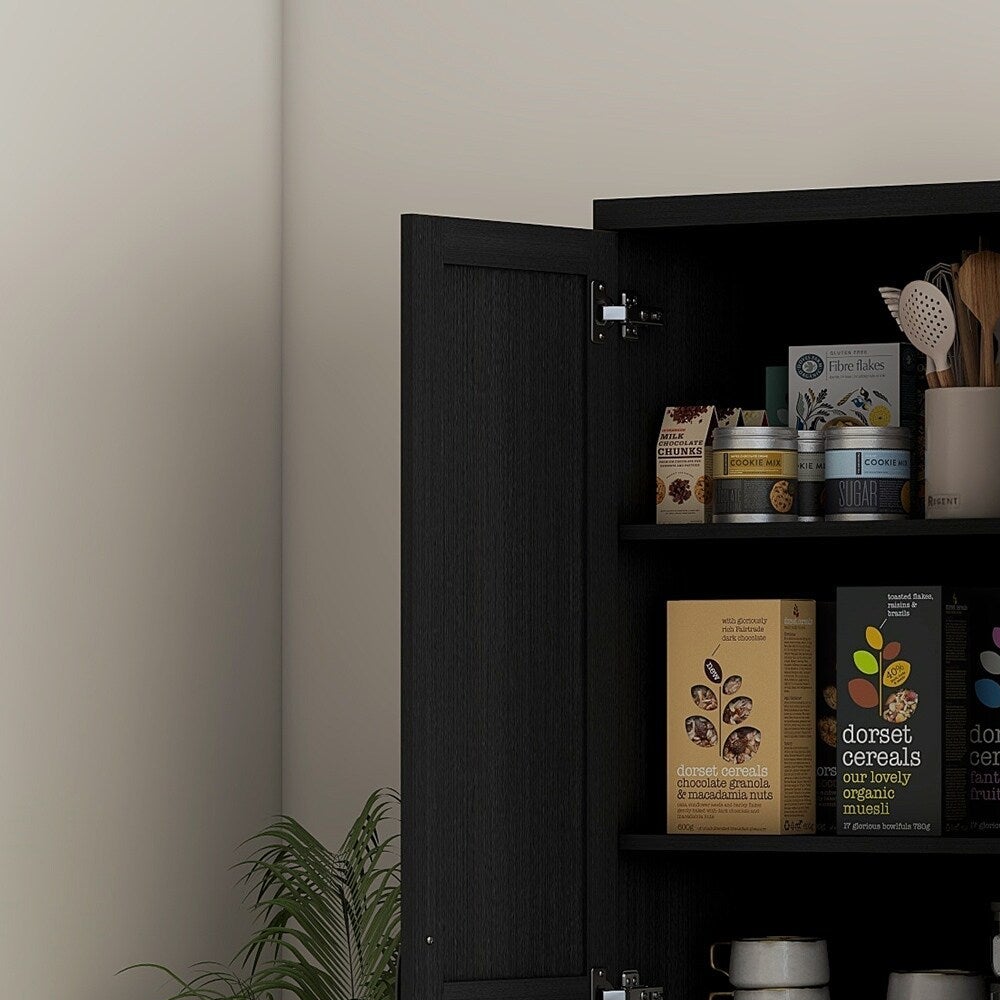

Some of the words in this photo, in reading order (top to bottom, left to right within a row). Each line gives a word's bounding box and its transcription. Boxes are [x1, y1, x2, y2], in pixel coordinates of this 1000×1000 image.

[829, 360, 854, 372] Fibre
[856, 358, 885, 372] flakes
[658, 447, 702, 456] CHUNKS
[730, 459, 763, 467] COOKIE
[765, 459, 781, 467] MIX
[864, 459, 897, 467] COOKIE
[839, 480, 878, 507] SUGAR
[737, 617, 768, 625] gloriously
[706, 661, 720, 681] new
[842, 724, 913, 744] dorset
[842, 747, 921, 767] cereals
[676, 764, 719, 777] dorset
[721, 764, 769, 777] cereals
[817, 766, 837, 777] ors
[676, 778, 727, 788] chocolate
[729, 778, 770, 790] granola
[842, 772, 868, 783] our
[870, 771, 911, 786] lovely
[676, 789, 687, 800] &
[688, 789, 748, 800] macadamia
[750, 790, 774, 800] nuts
[842, 786, 895, 801] organic
[842, 802, 890, 815] muesli
[852, 822, 881, 831] glorious
[882, 822, 912, 830] bowlfuls
[912, 822, 931, 831] 780g
